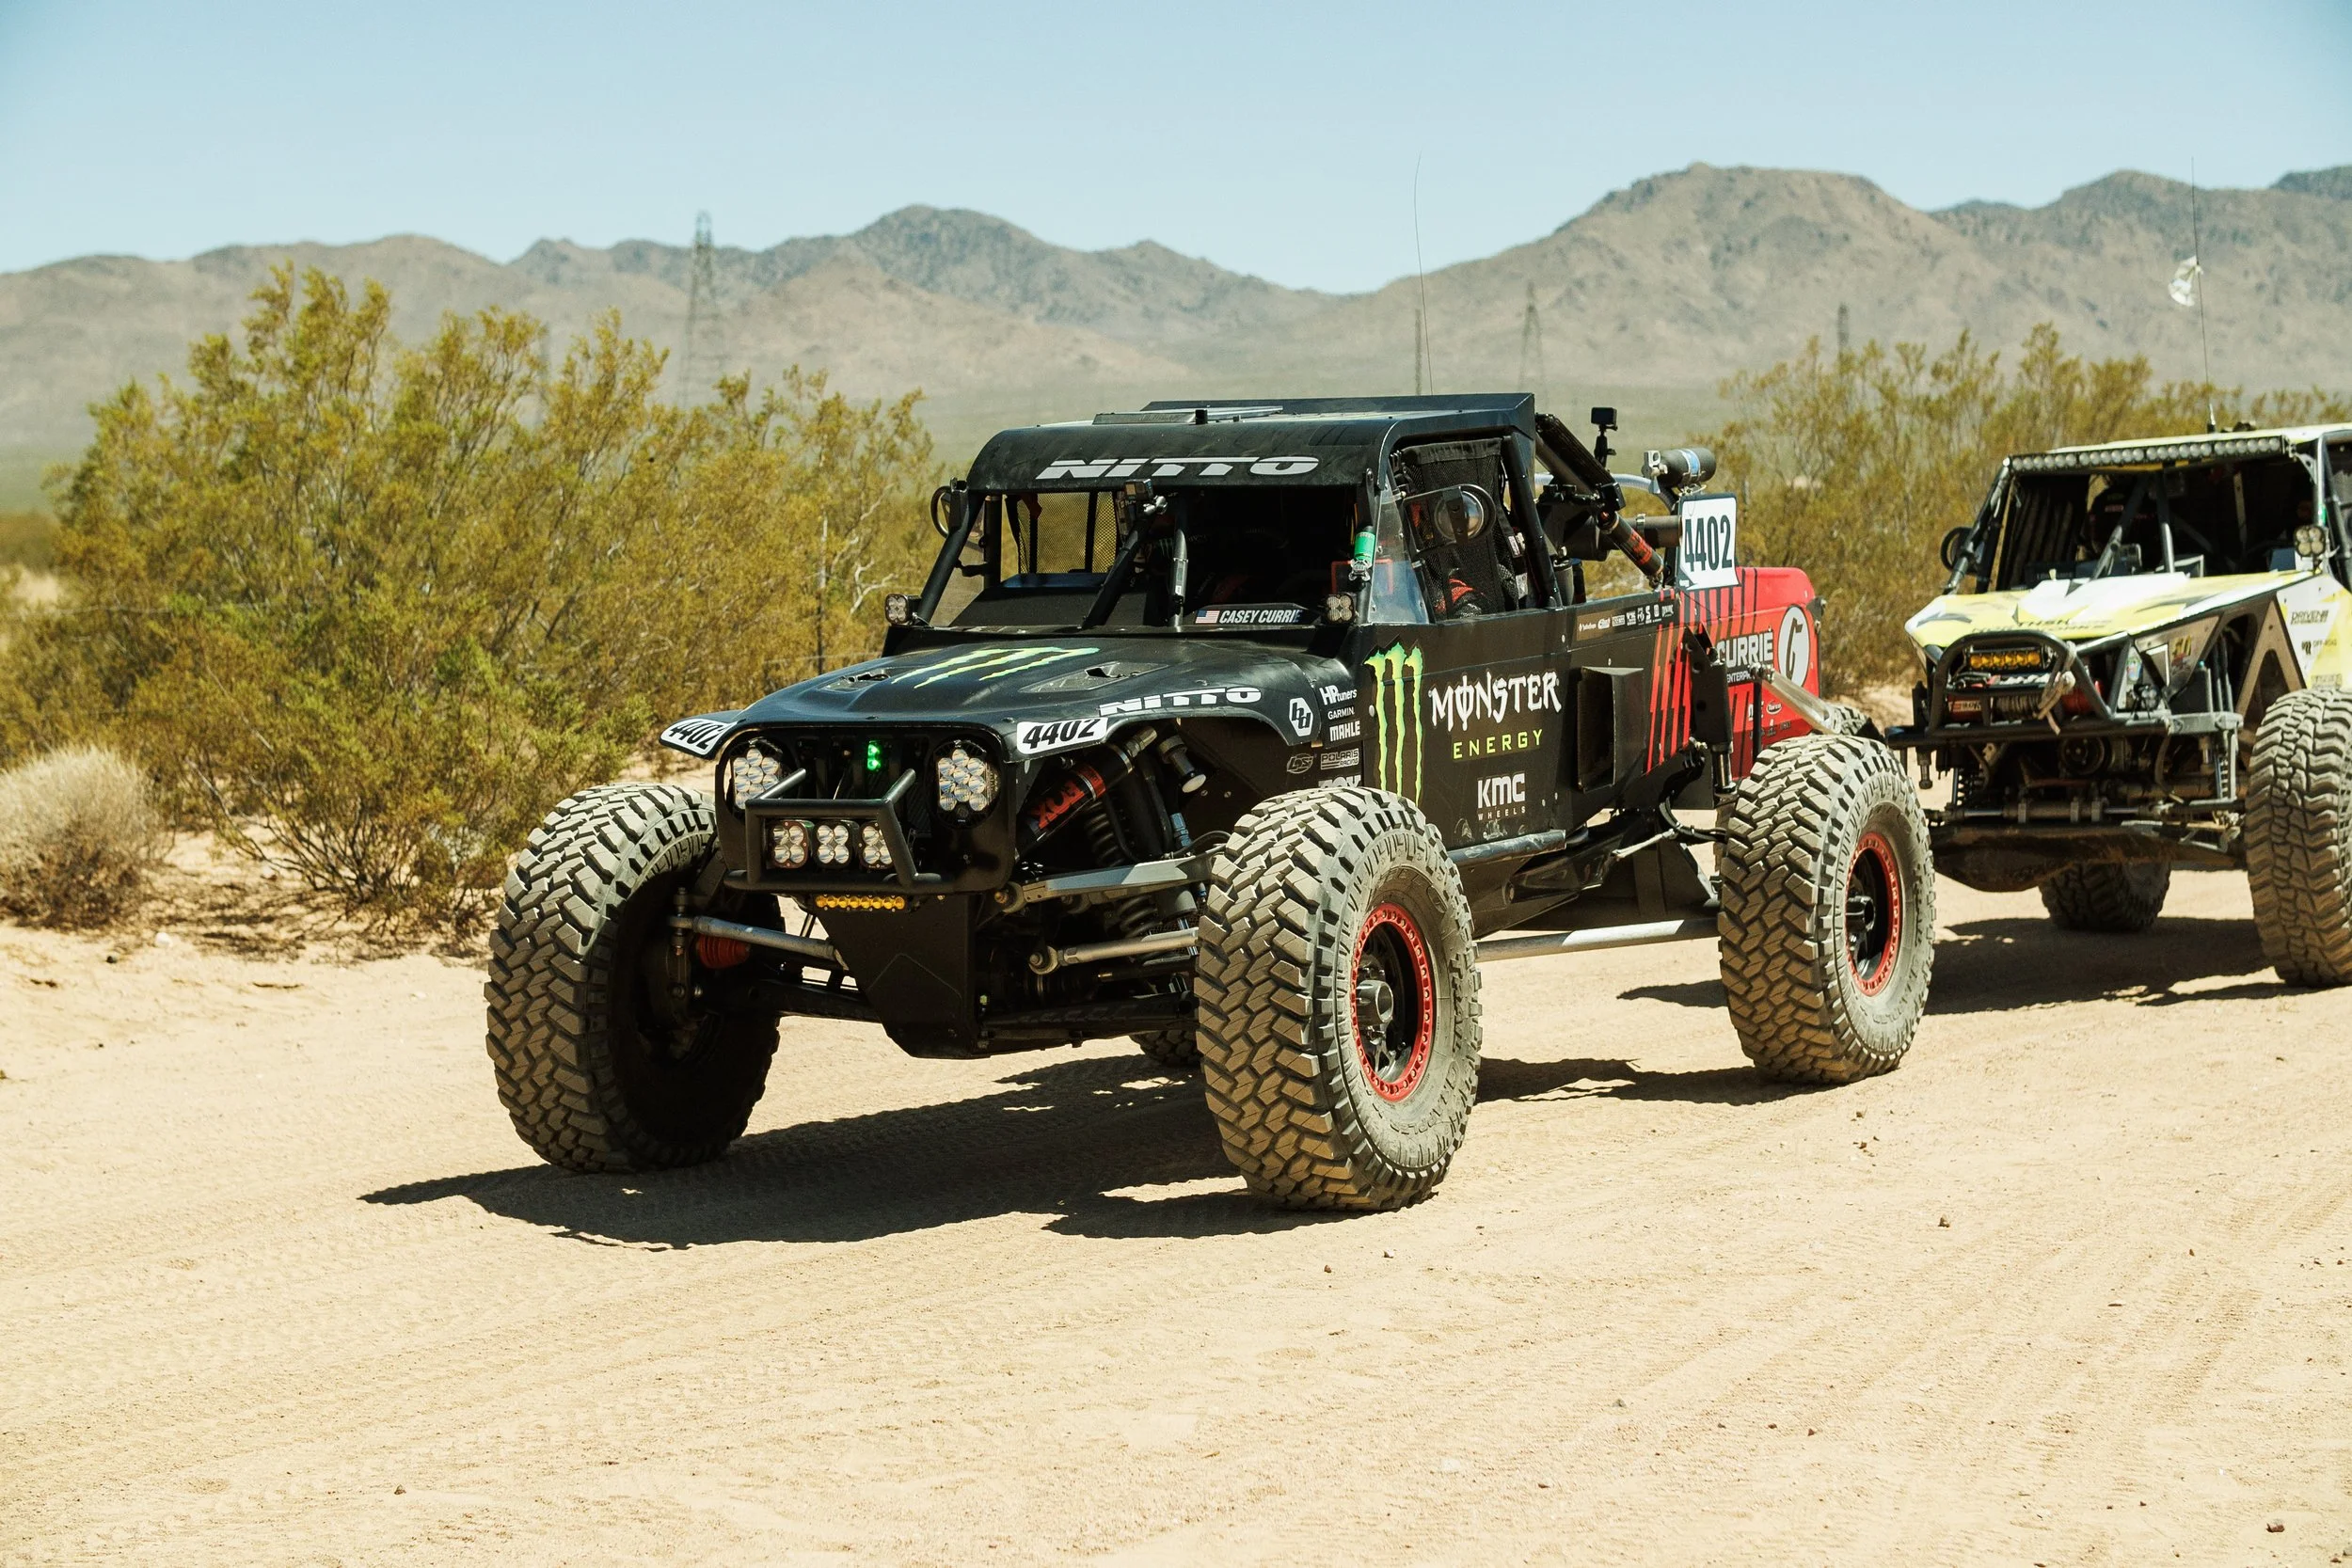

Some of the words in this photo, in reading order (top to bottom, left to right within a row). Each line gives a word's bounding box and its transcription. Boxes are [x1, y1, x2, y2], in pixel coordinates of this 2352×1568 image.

[1035, 456, 1320, 481] NITTO
[1684, 515, 1733, 573] 4402
[1218, 610, 1260, 625] CASEY
[1258, 610, 1303, 625] CURRIE
[1717, 631, 1773, 669] CURRIE
[1099, 687, 1262, 717] NITTO
[1327, 706, 1355, 721] GARMIN
[1428, 671, 1563, 733] MONSTER
[668, 720, 724, 751] 4402
[1022, 718, 1102, 750] 4402
[1329, 721, 1361, 742] MAHLE
[1453, 728, 1543, 759] ENERGY
[1321, 750, 1359, 763] POLARIS
[1477, 772, 1526, 809] KMC
[1477, 806, 1526, 821] WHEELS
